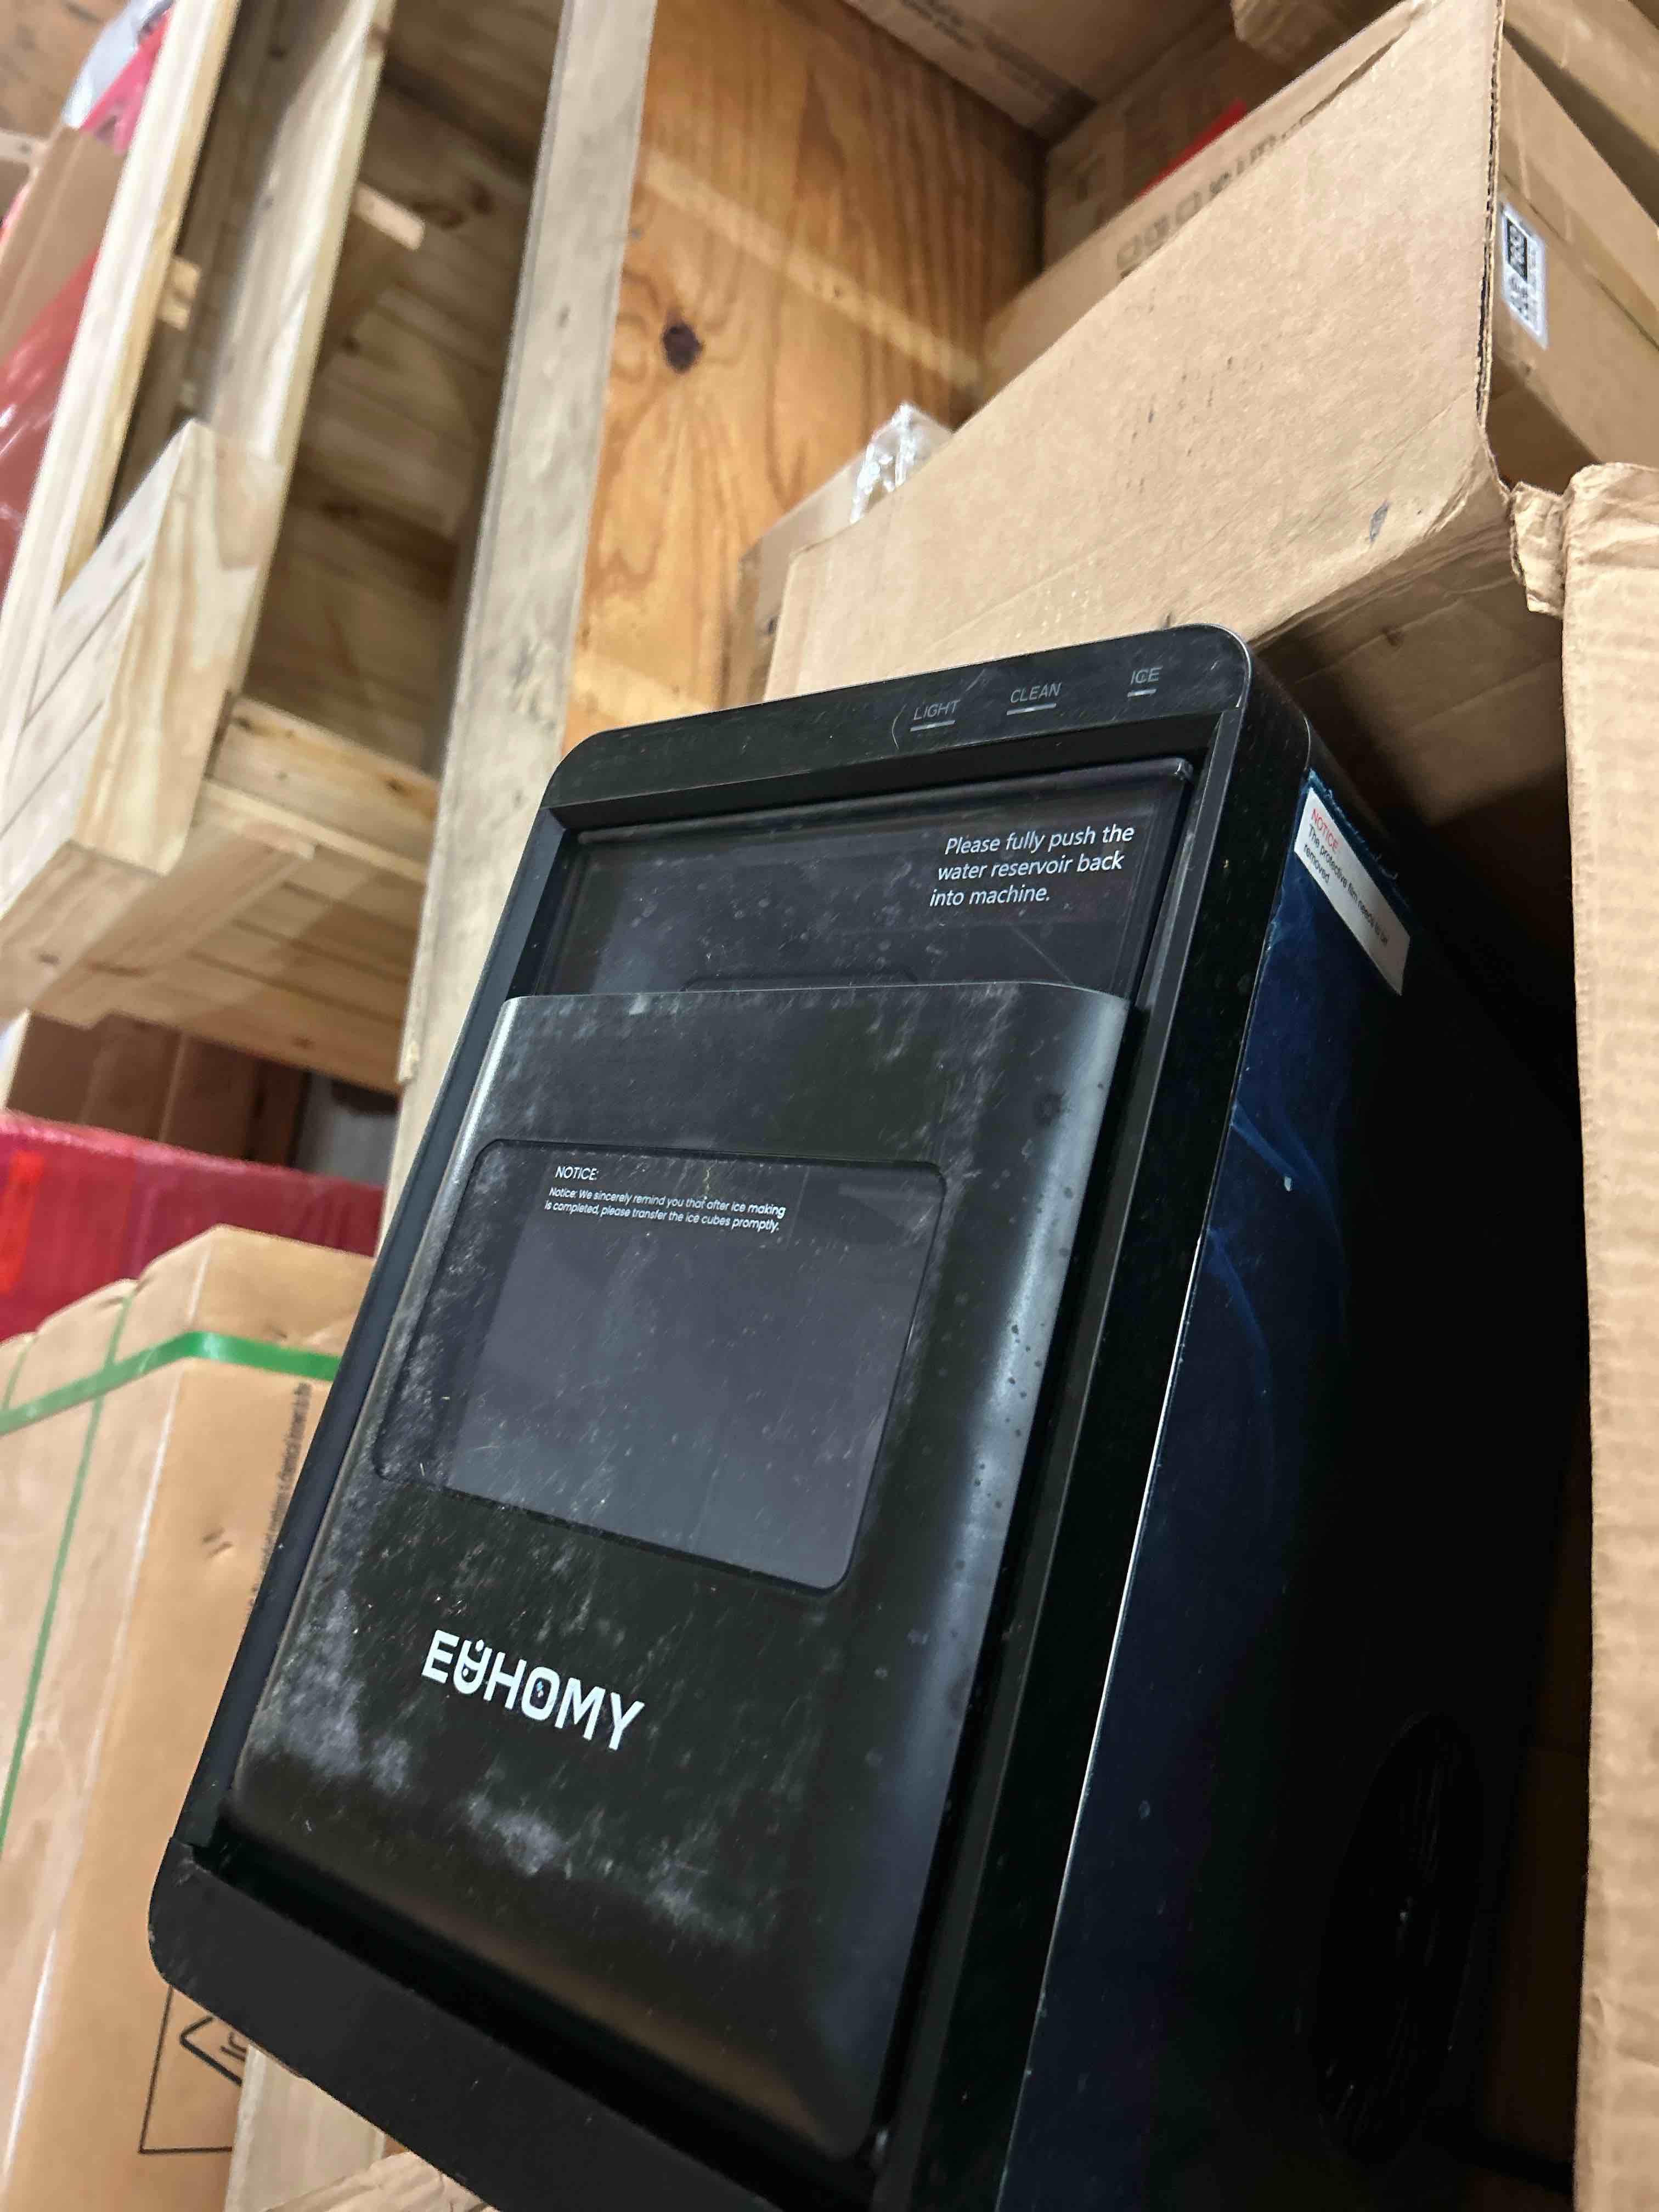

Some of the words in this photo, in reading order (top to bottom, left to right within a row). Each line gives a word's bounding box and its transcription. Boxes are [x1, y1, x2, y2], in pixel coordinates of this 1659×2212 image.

[1130, 665, 1163, 685] ICE
[1010, 682, 1062, 703] CLEAN
[913, 699, 961, 721] LIGHT
[945, 837, 1001, 855] Please
[1006, 831, 1045, 854] fully
[1048, 826, 1096, 852] push
[1102, 824, 1135, 843] the
[1309, 823, 1320, 848] The
[1312, 809, 1339, 853] NOTICE
[938, 864, 988, 881] water
[991, 855, 1074, 877] reservoir
[1076, 850, 1125, 872] back
[929, 889, 965, 906] into
[969, 884, 1050, 905] machine.
[553, 1202, 600, 1215] completed,
[600, 1205, 630, 1217] please
[632, 1208, 668, 1221] transfer
[668, 1210, 684, 1222] the
[701, 1214, 731, 1227] cubes
[731, 1217, 780, 1234] promptly.
[579, 1189, 593, 1199] We
[594, 1191, 631, 1205] sincerely
[633, 1195, 666, 1206] remind
[666, 1198, 684, 1209] you
[686, 1197, 707, 1209] that
[707, 1200, 730, 1211] after
[747, 1204, 786, 1220] making
[421, 1629, 645, 1751] EUHOMY
